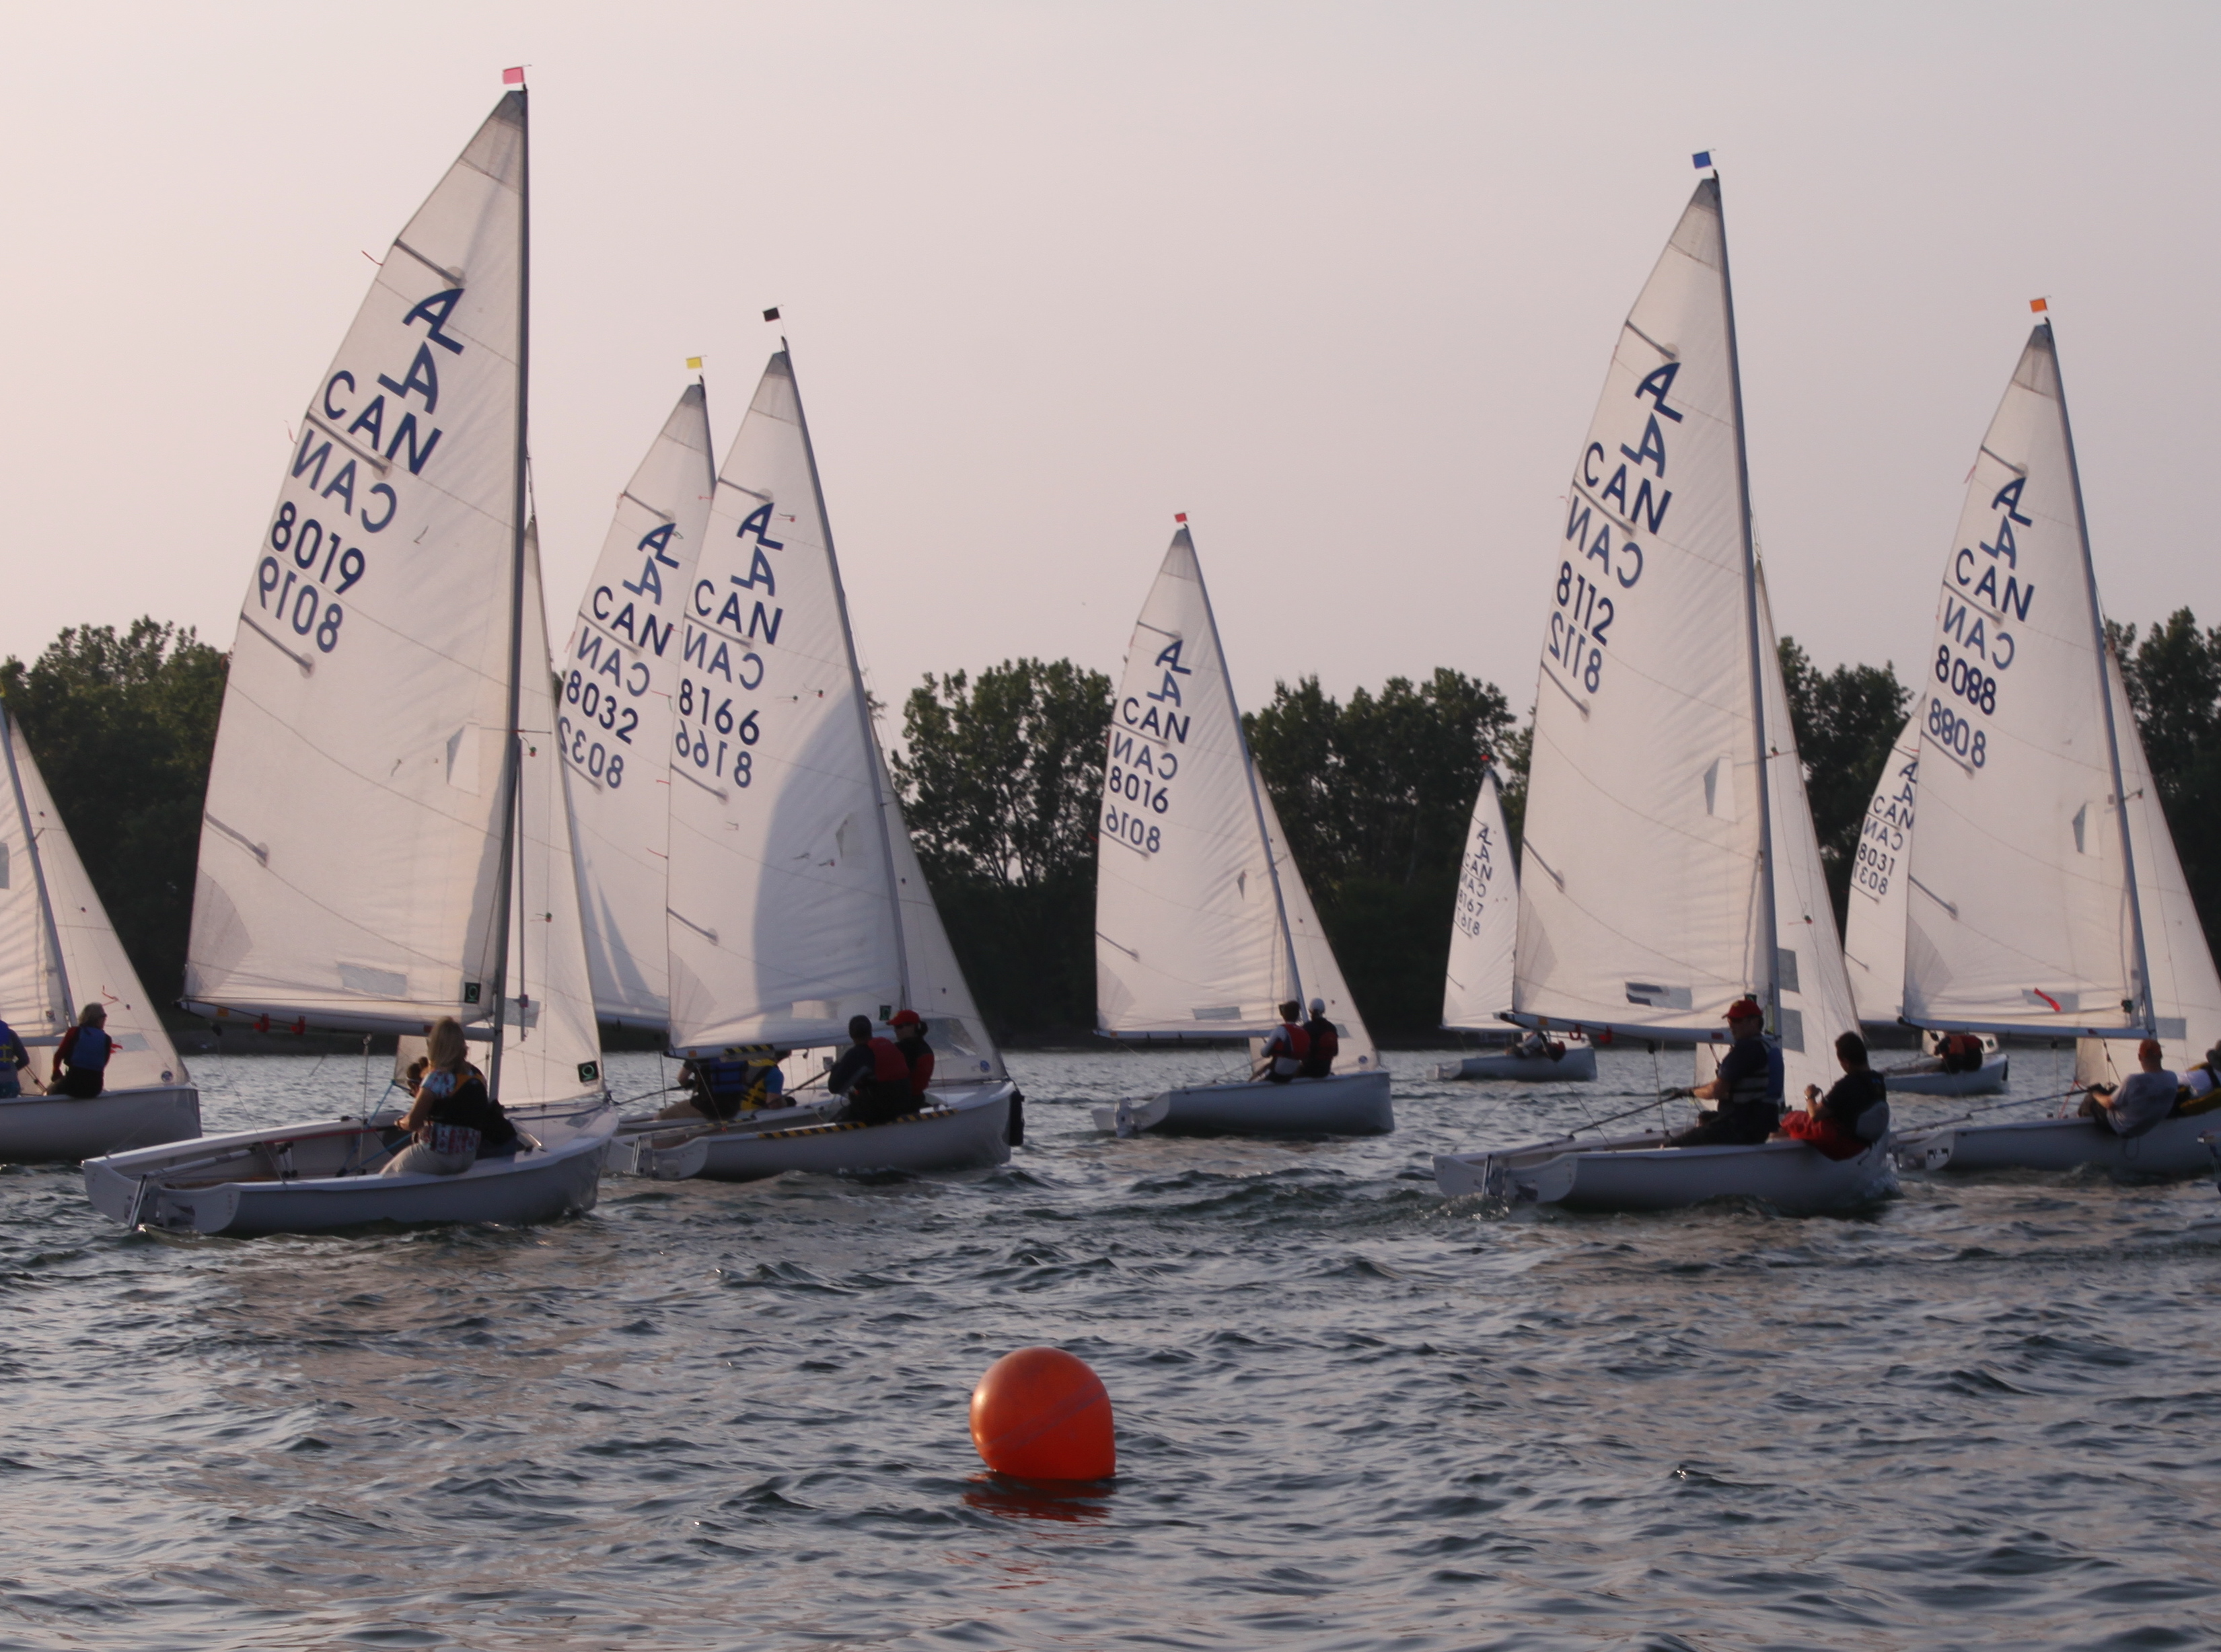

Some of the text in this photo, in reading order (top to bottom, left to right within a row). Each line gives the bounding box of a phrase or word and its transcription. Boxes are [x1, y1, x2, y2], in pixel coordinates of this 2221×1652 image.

[324, 370, 443, 476] CAN
[1584, 441, 1673, 536] CAN
[270, 501, 365, 595] 8019
[695, 580, 783, 645] CAN
[1556, 560, 1614, 648] 8112
[1955, 548, 2035, 622] CAN
[593, 586, 673, 657] CAN
[566, 670, 639, 745] 8032
[679, 678, 760, 746] 8166
[1935, 644, 1996, 716] 8088
[1123, 697, 1191, 744] CAN
[1109, 765, 1169, 815] 8016
[1873, 796, 1914, 829] CAN
[1858, 843, 1895, 876] 8031
